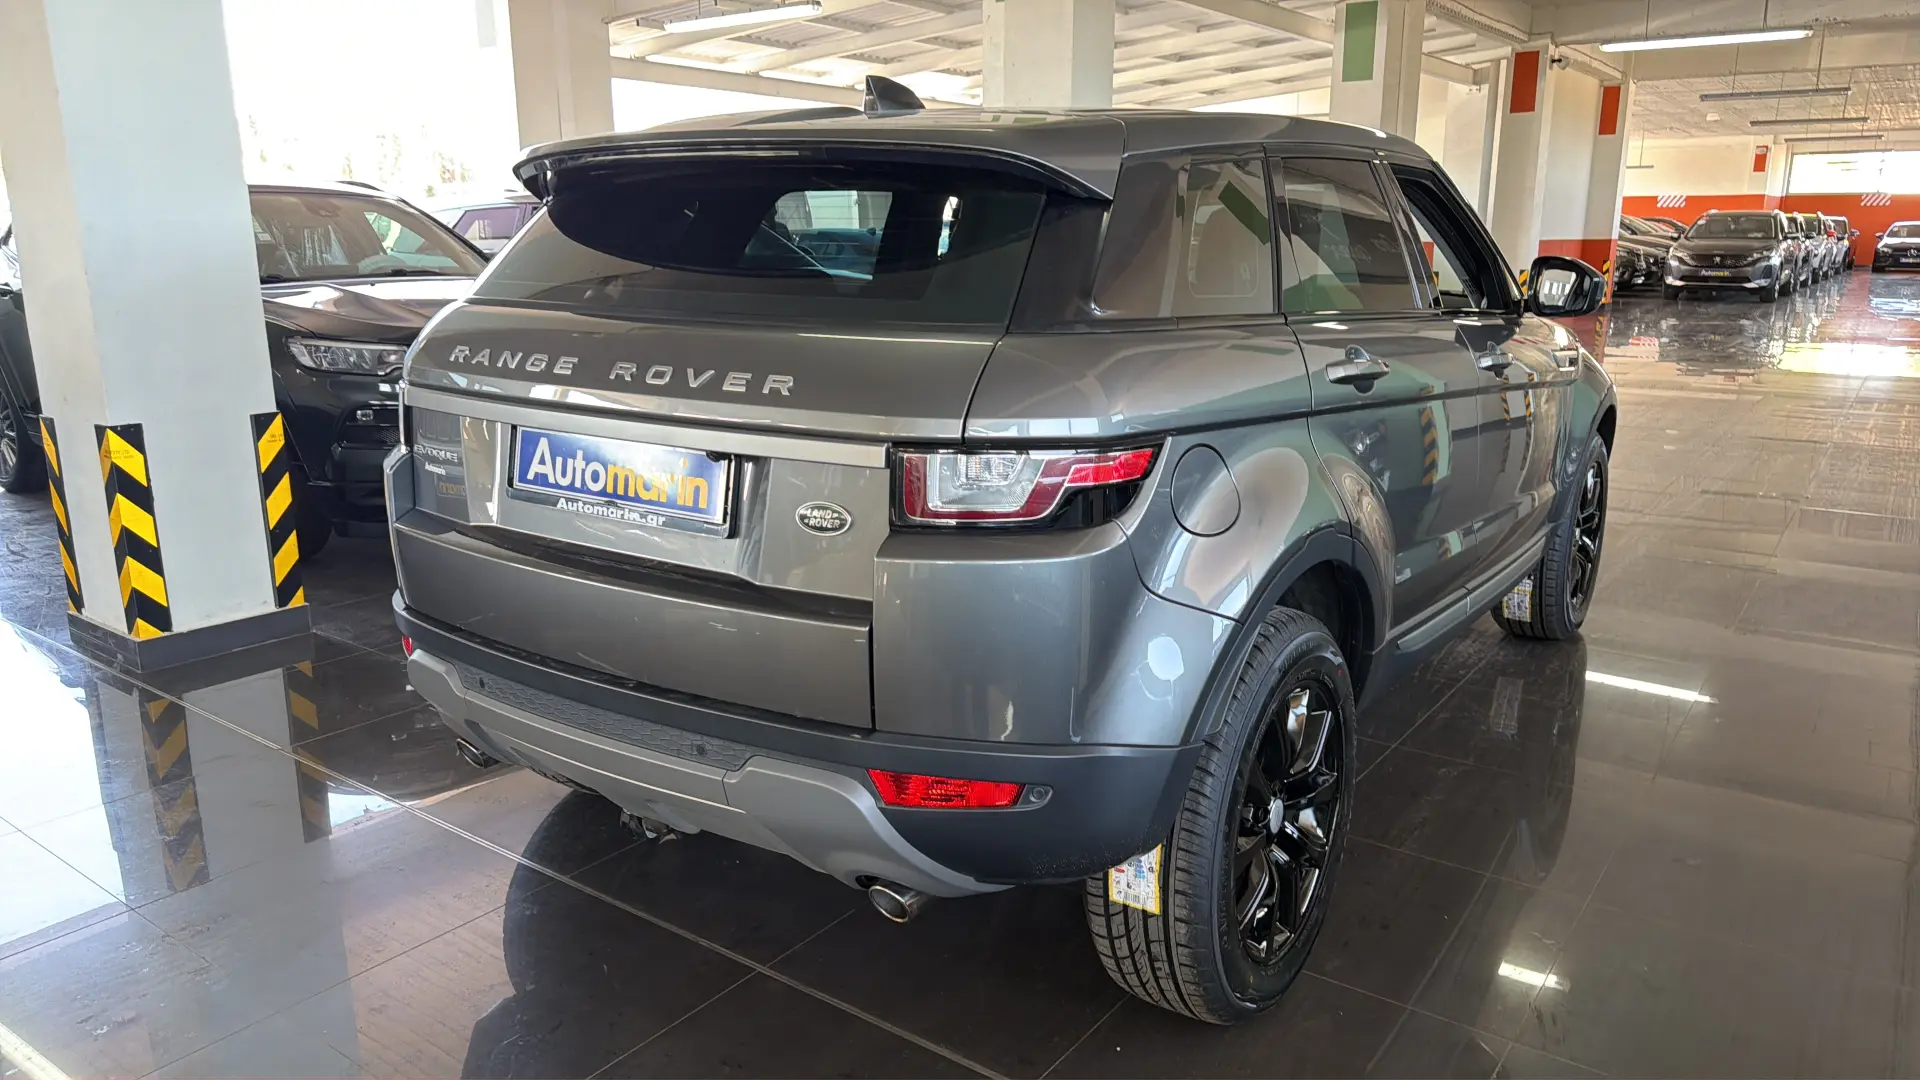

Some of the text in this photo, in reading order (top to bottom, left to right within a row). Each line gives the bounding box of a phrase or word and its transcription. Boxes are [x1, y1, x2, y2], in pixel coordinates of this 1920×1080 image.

[449, 345, 794, 396] RANGE ROVER
[414, 443, 458, 462] EVOQUE
[526, 437, 709, 509] Automarin
[556, 497, 666, 527] Automarin.gr
[806, 508, 833, 519] LAND
[808, 517, 841, 528] ROVER
